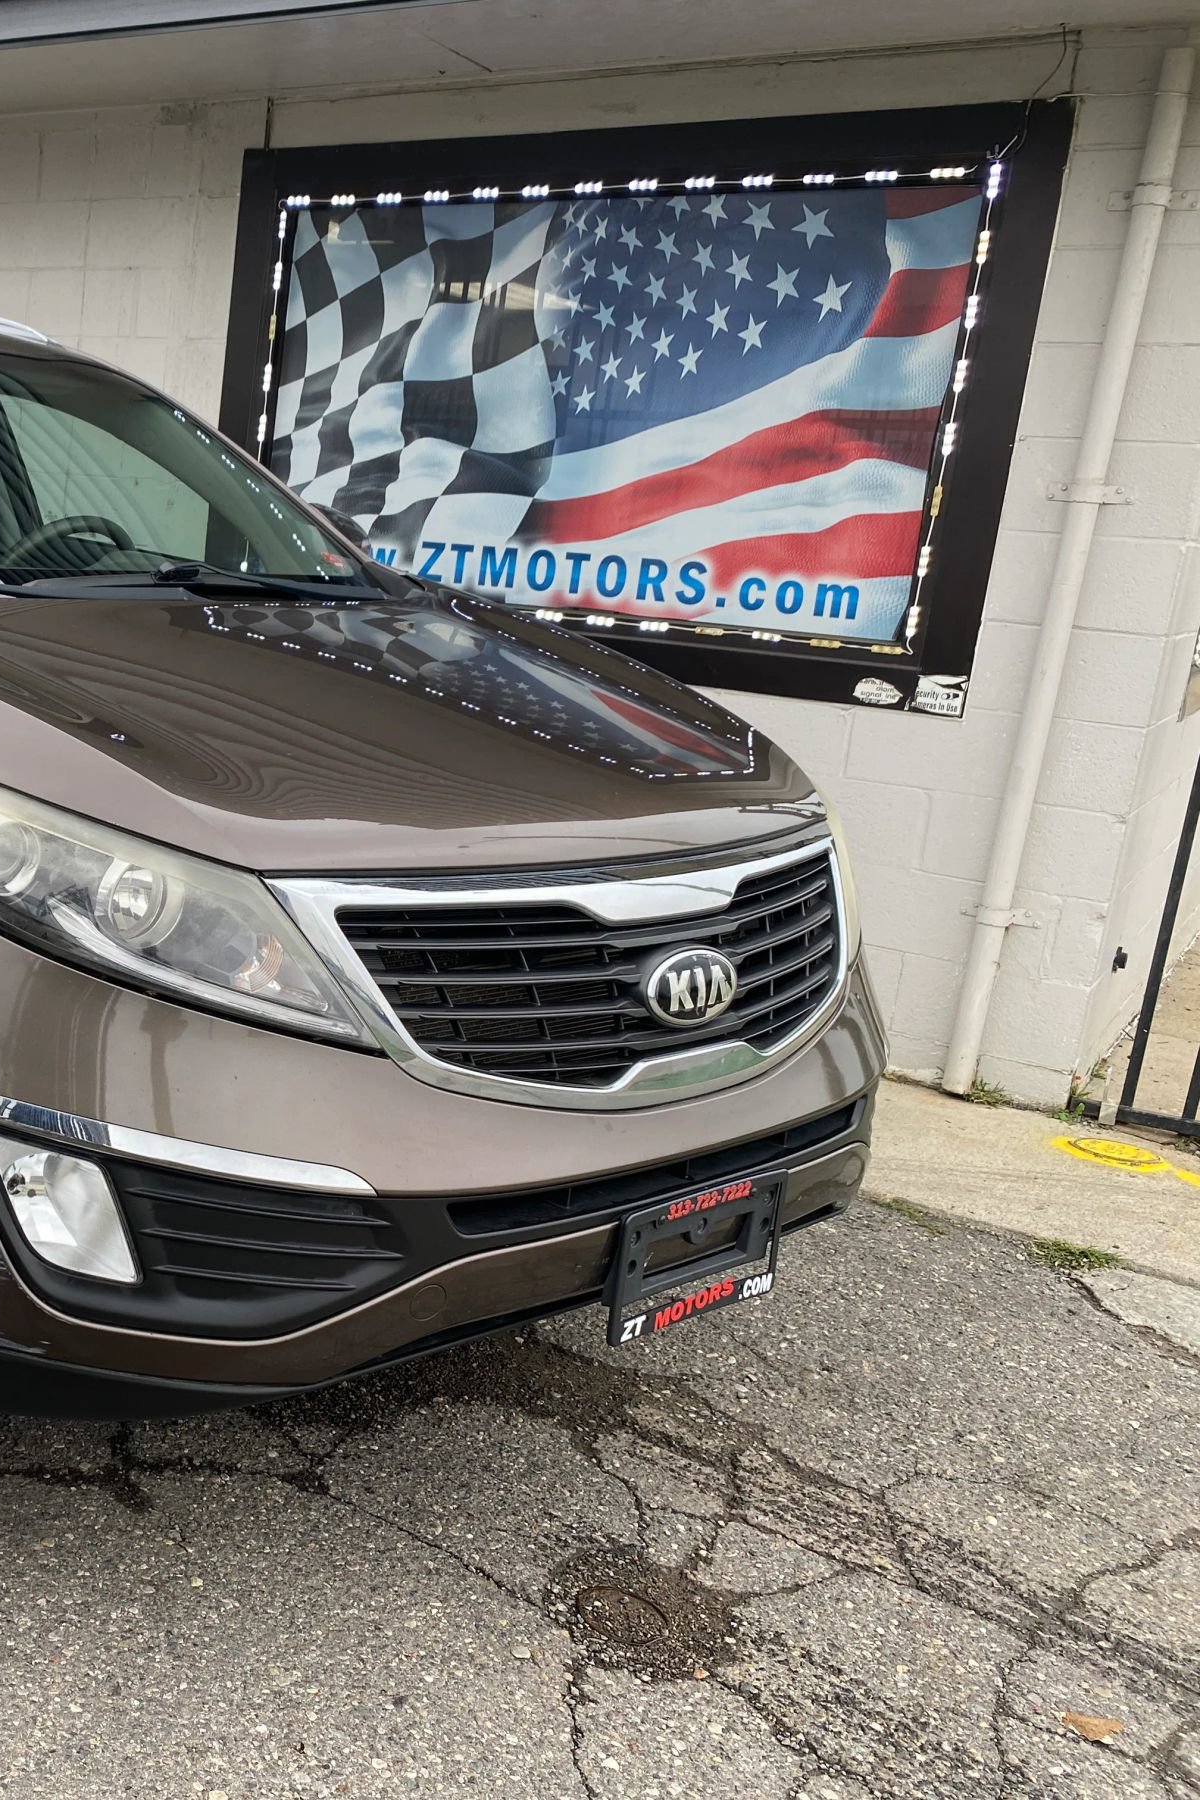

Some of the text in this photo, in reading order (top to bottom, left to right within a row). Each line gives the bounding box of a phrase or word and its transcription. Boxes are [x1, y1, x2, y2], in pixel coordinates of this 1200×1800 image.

[915, 690, 940, 701] ecurity
[666, 964, 729, 1012] KIA
[667, 1180, 752, 1220] 313-722-7222
[620, 1273, 773, 1343] ZT MOTORS .COM
